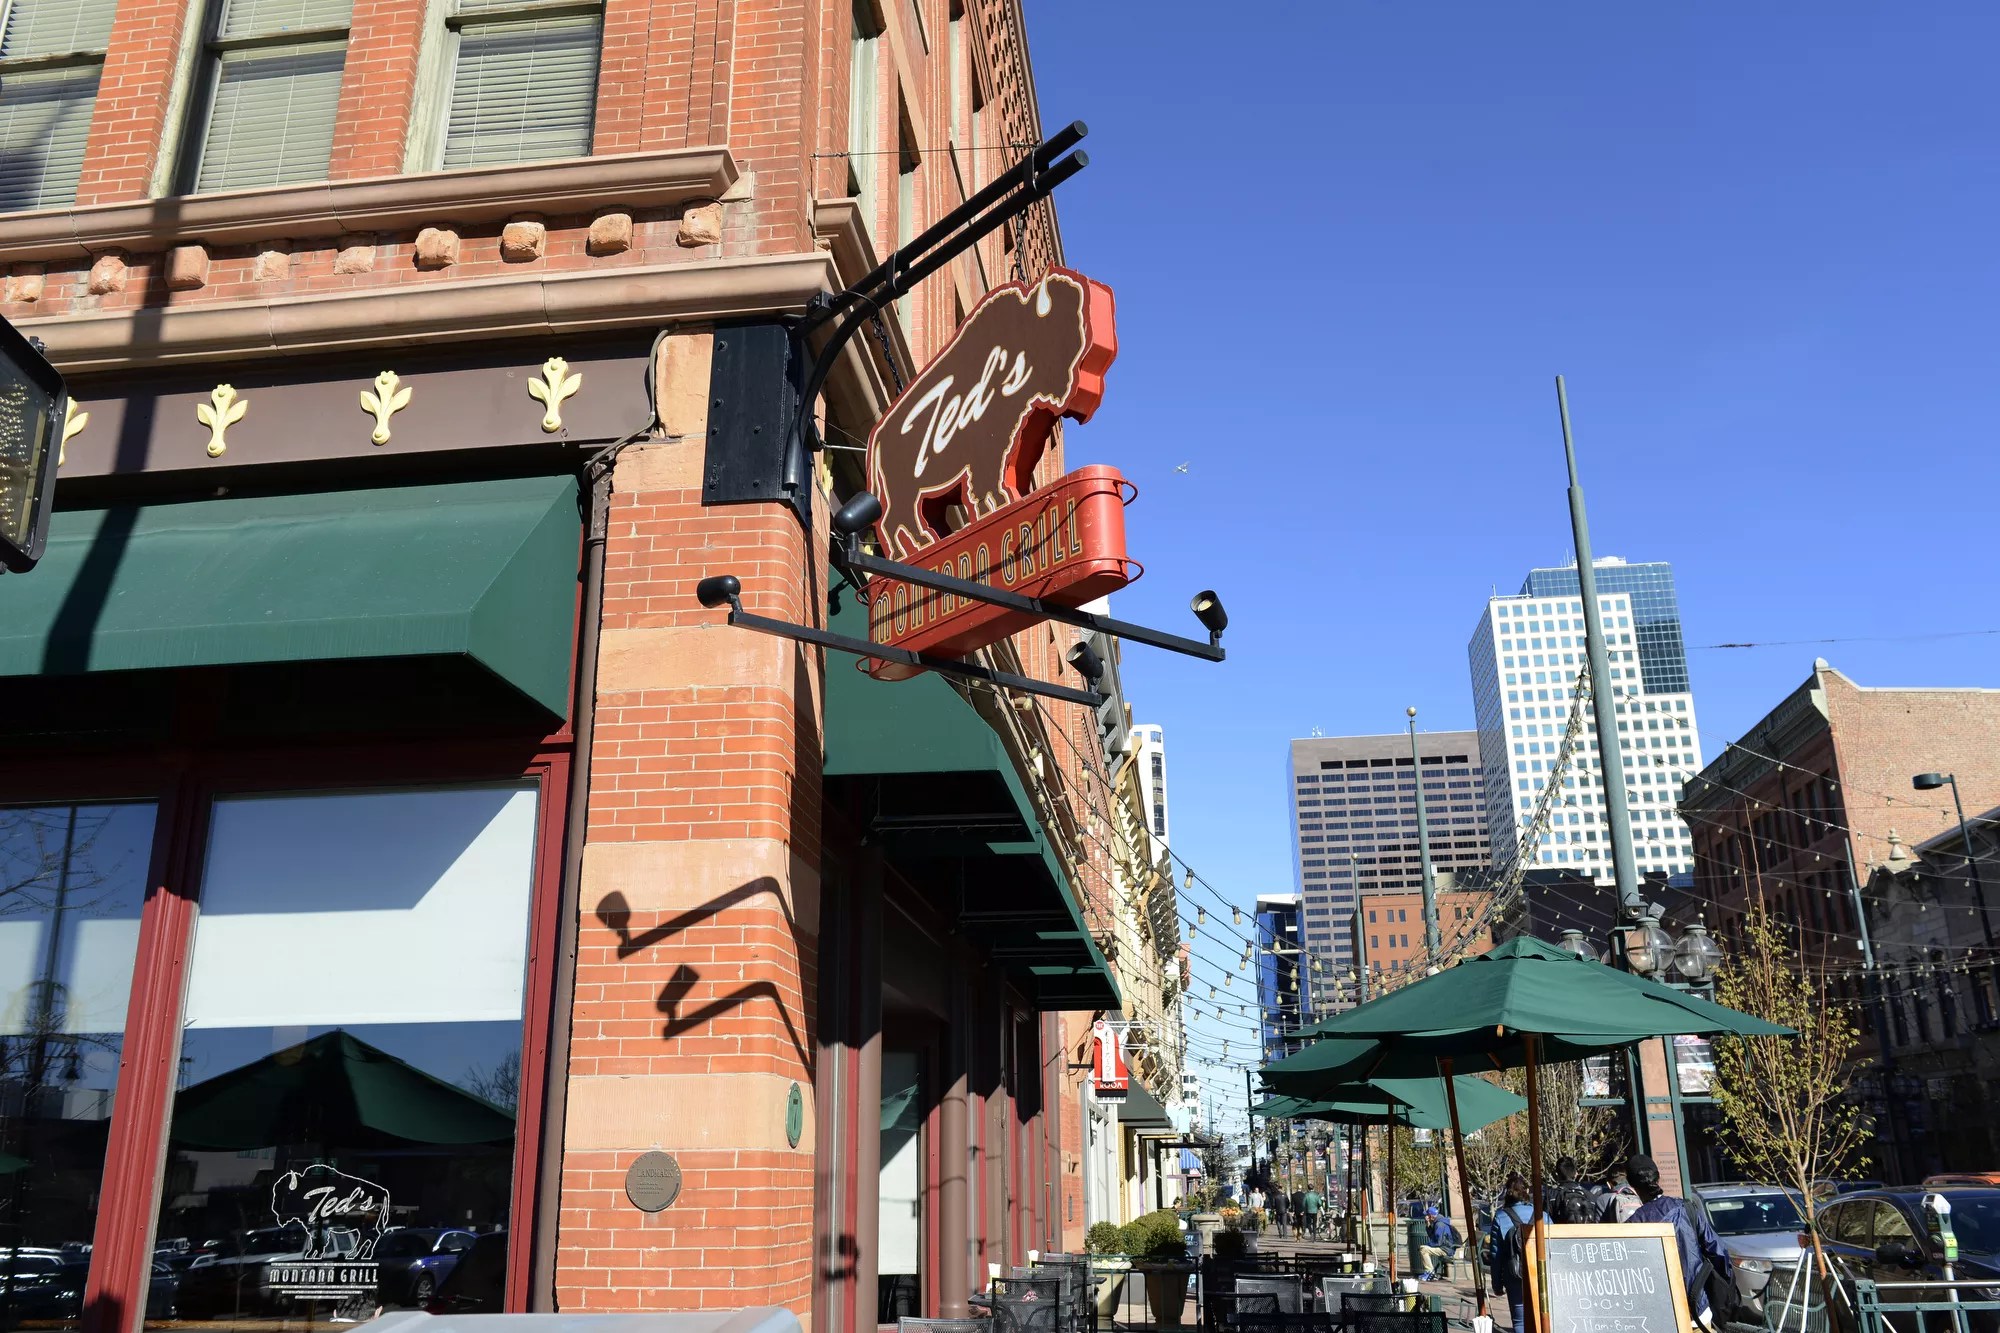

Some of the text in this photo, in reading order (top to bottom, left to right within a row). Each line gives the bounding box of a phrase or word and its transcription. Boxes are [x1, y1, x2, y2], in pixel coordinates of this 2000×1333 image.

[901, 345, 1034, 478] Ted's
[1001, 497, 1083, 587] GRILL
[303, 1186, 375, 1222] Ted's
[1571, 1241, 1629, 1263] OPEN
[269, 1268, 379, 1283] MONTANA GRILL
[1552, 1267, 1655, 1297] THANKSGIVING
